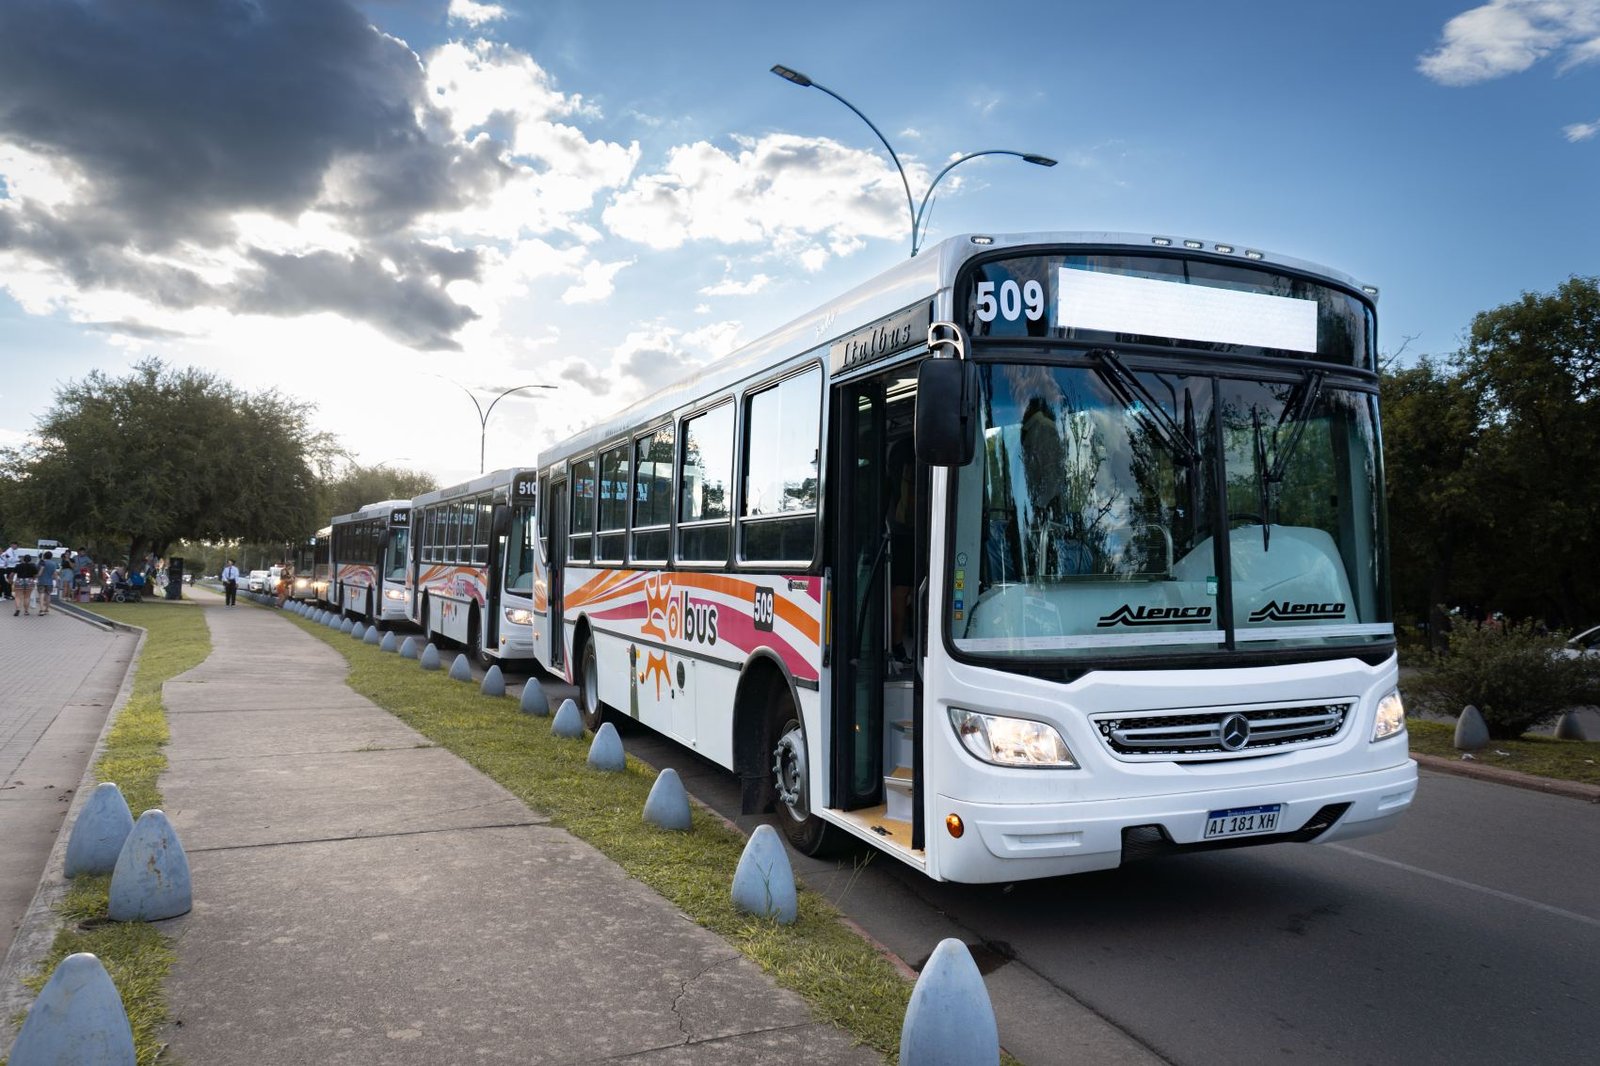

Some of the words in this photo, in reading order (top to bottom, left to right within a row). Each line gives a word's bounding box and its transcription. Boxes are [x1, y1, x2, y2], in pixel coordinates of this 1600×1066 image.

[976, 279, 1044, 323] 509
[519, 481, 537, 495] 510
[394, 513, 406, 522] 514
[754, 592, 774, 624] 509
[1097, 603, 1212, 628] Alenco
[1248, 600, 1346, 623] Alenco
[1209, 819, 1226, 835] AI
[1229, 816, 1255, 833] 181
[1258, 813, 1276, 830] XH
